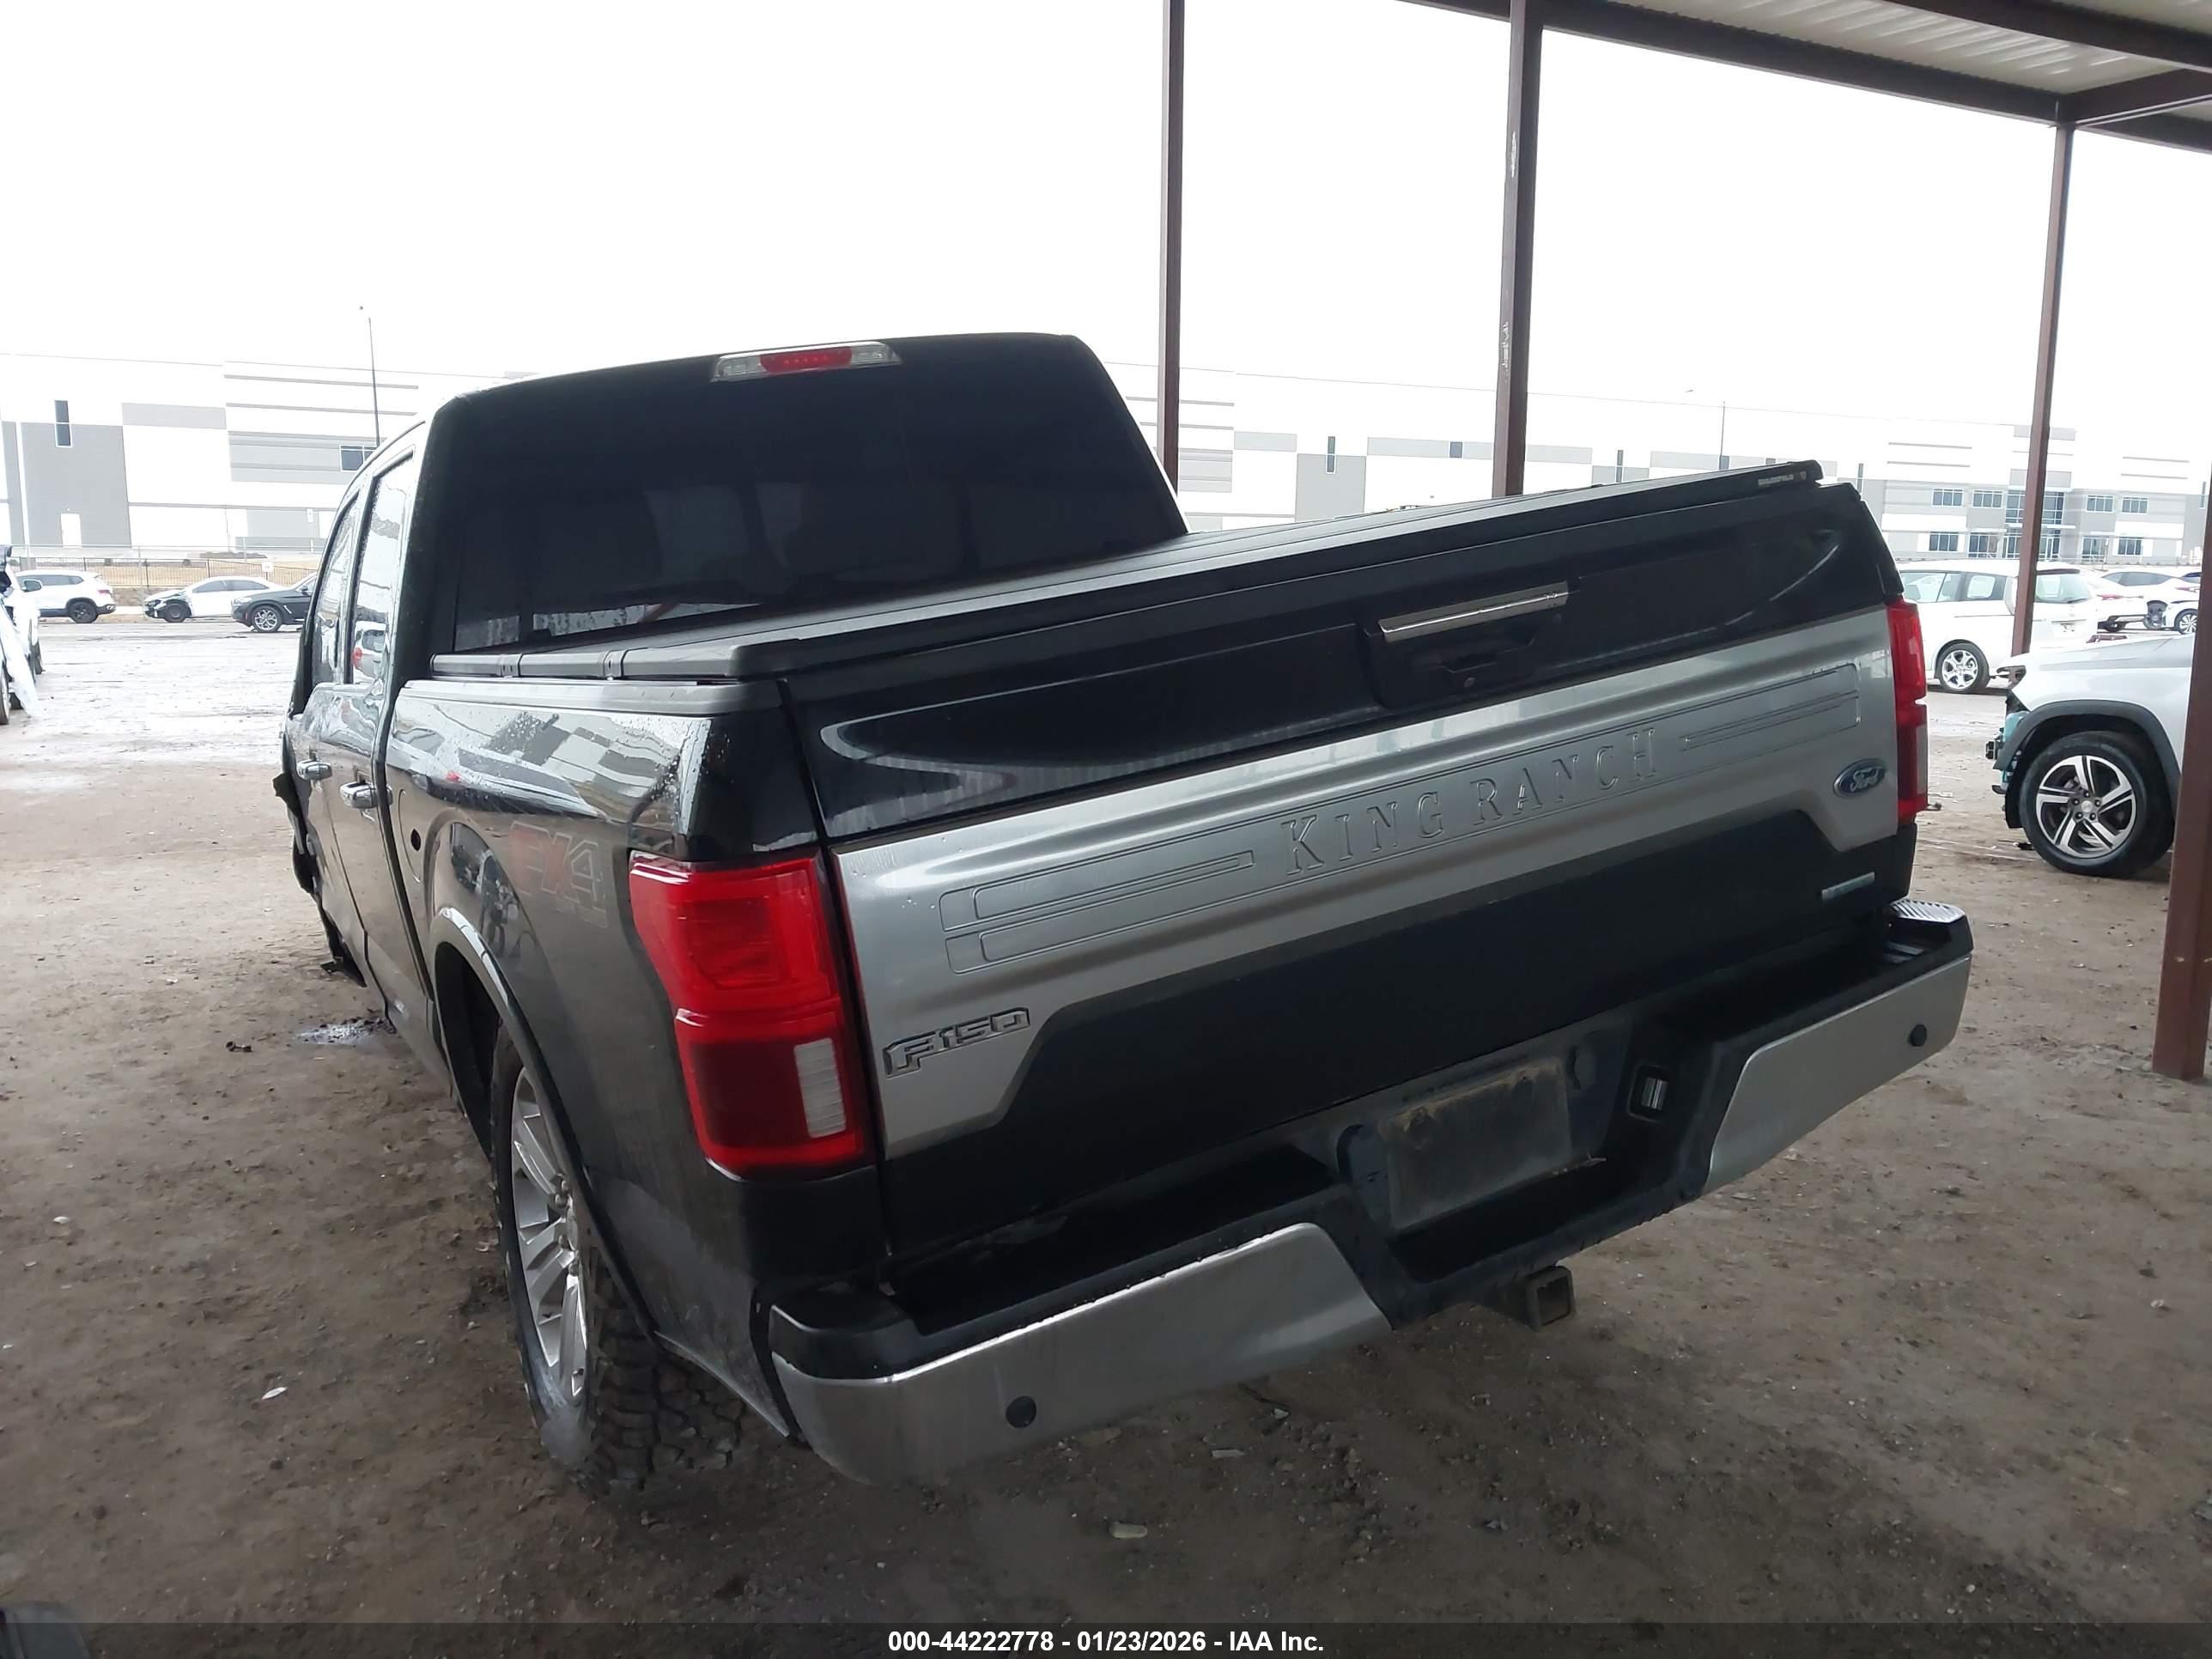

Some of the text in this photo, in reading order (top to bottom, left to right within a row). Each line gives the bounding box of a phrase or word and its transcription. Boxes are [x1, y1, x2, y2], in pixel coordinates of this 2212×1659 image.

[1280, 727, 1657, 876] KING RANCH
[1850, 766, 1883, 793] Ford
